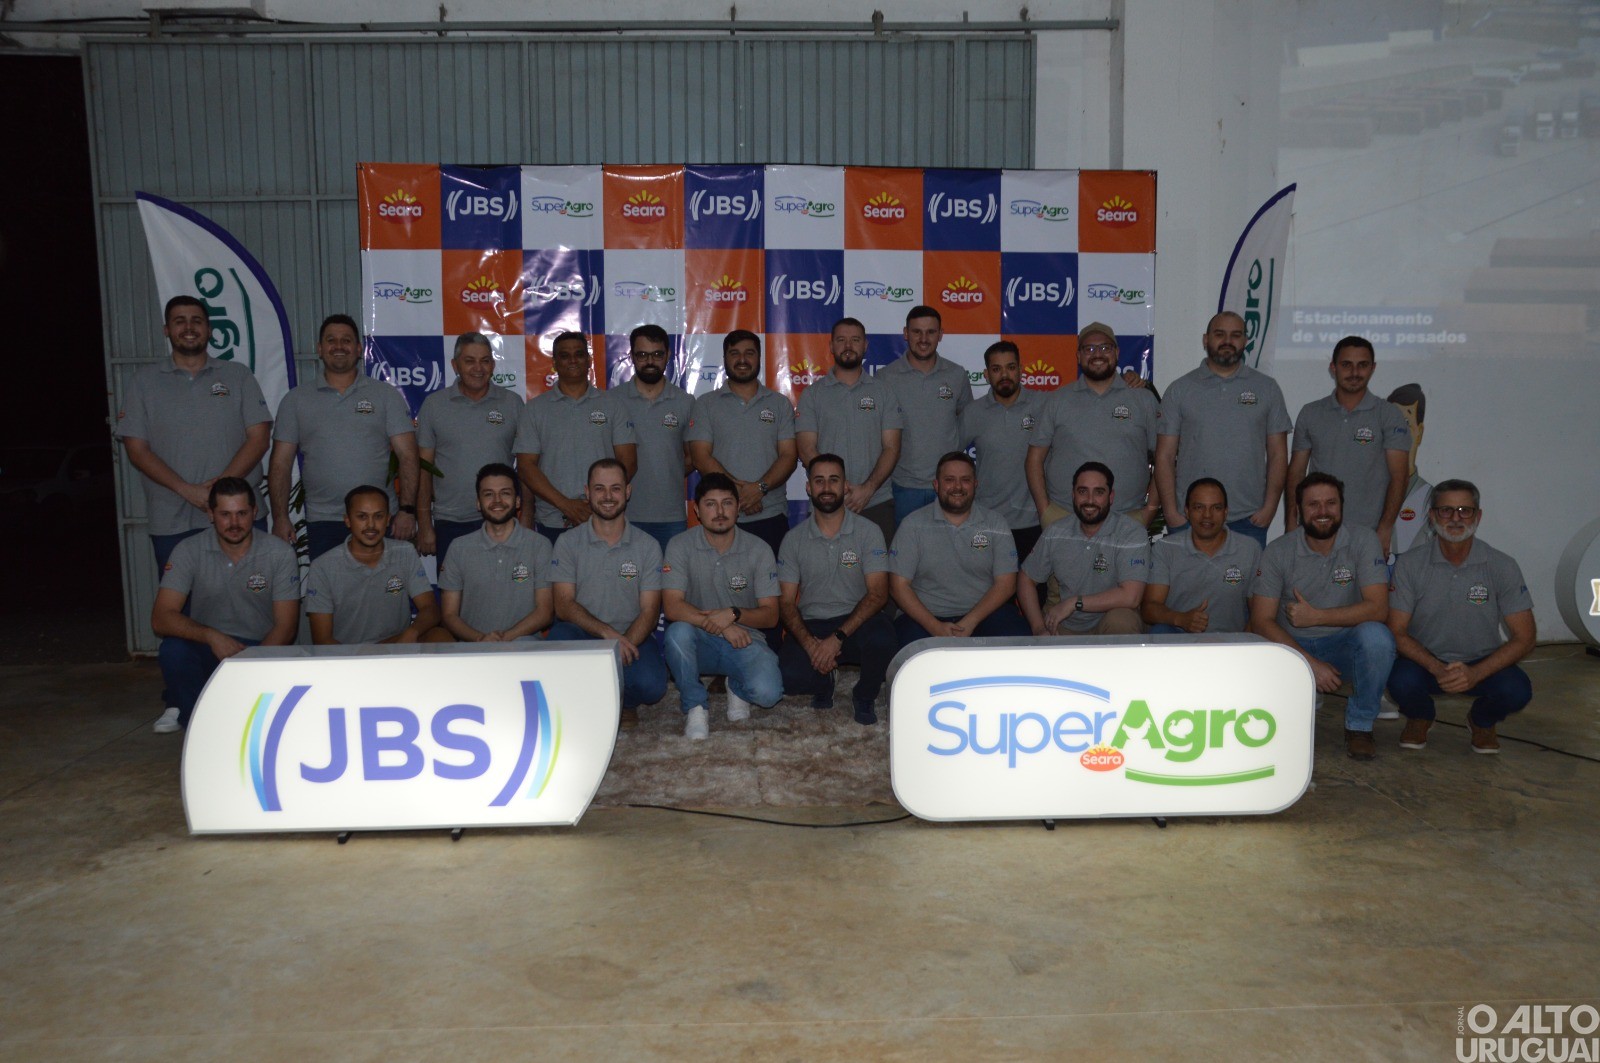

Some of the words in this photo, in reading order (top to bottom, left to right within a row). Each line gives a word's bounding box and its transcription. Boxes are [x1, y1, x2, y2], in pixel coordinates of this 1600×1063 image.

[378, 203, 422, 218] Seara
[459, 195, 504, 216] JBS
[622, 203, 665, 218] Seara
[702, 195, 746, 216] JBS
[863, 204, 905, 219] Seara
[940, 198, 983, 218] JBS
[1097, 208, 1137, 222] Seara
[705, 287, 747, 302] Seara
[783, 279, 826, 300] JBS
[941, 288, 983, 303] Seara
[1018, 282, 1060, 302] JBS
[1292, 311, 1433, 325] Estacionamento
[1292, 329, 1313, 342] de
[1395, 330, 1467, 346] pesados
[1020, 373, 1059, 386] Seara
[300, 703, 492, 784] JBS
[1081, 753, 1123, 766] Seara
